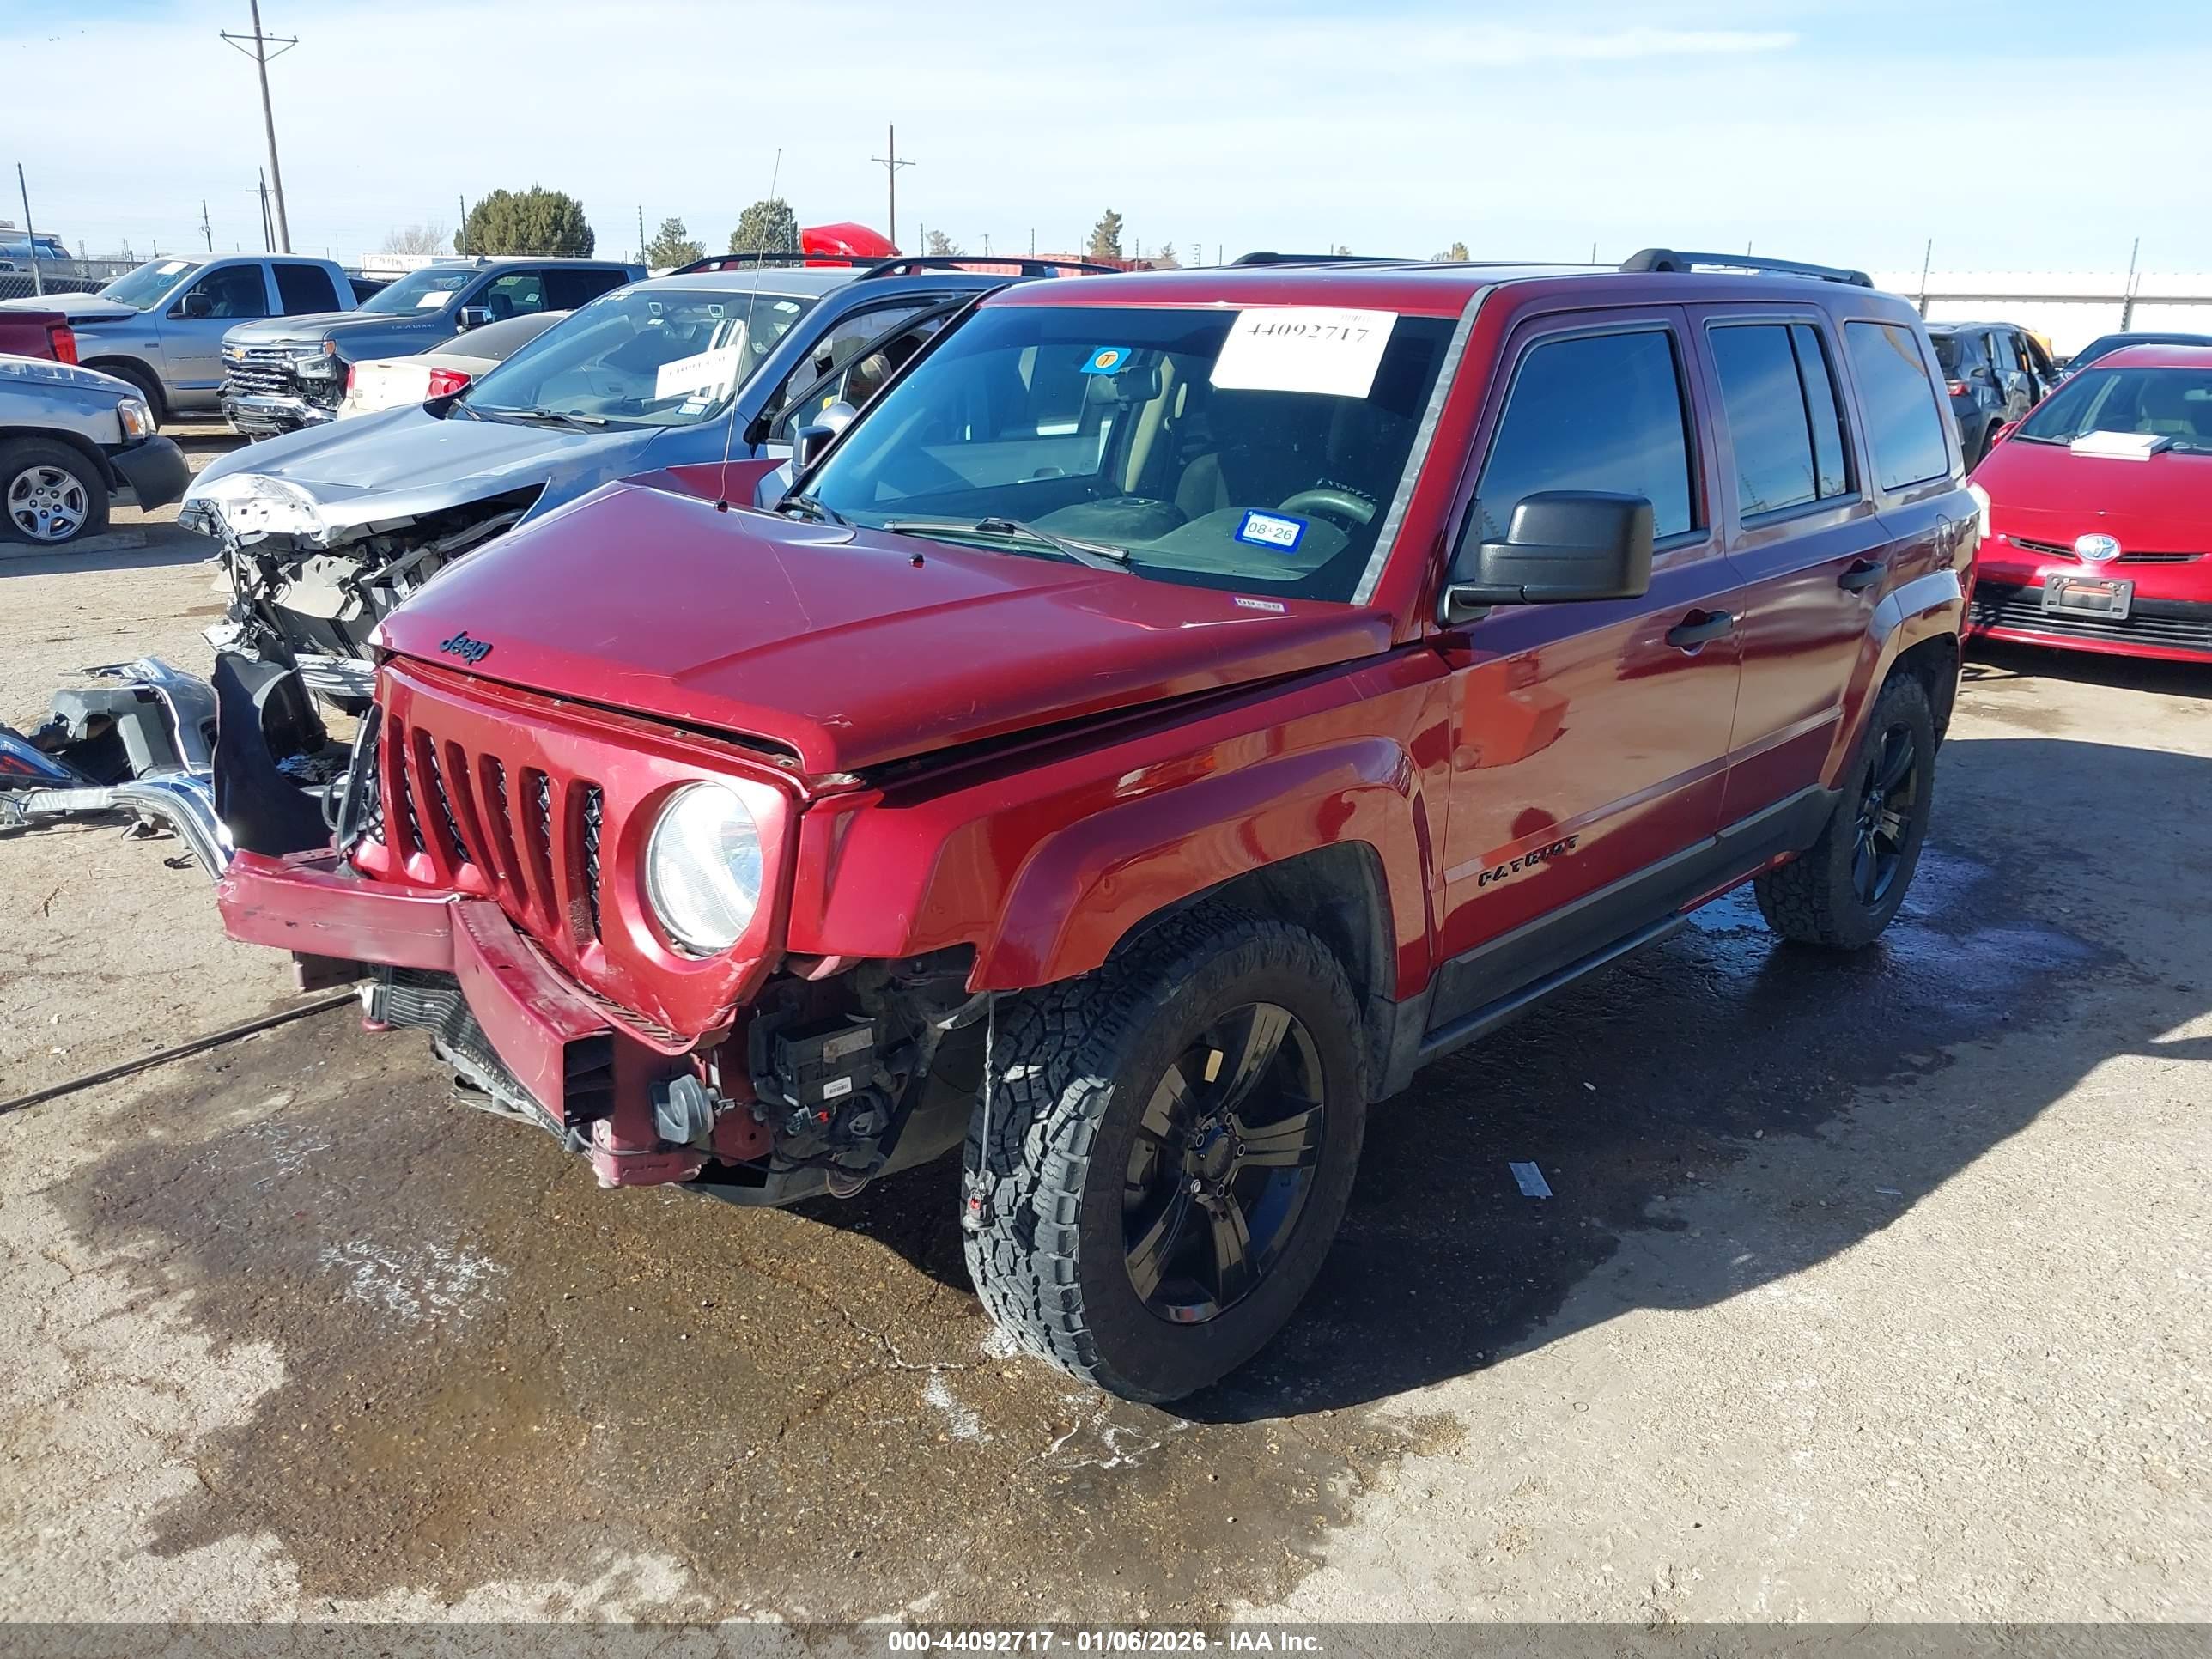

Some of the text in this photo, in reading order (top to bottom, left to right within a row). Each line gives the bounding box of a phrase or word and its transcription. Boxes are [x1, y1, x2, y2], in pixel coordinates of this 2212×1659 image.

[1247, 323, 1370, 343] 44092717
[1248, 521, 1268, 535] 08
[1272, 526, 1294, 541] 26
[439, 630, 494, 666] Jeep
[1477, 834, 1580, 888] PATRIOT
